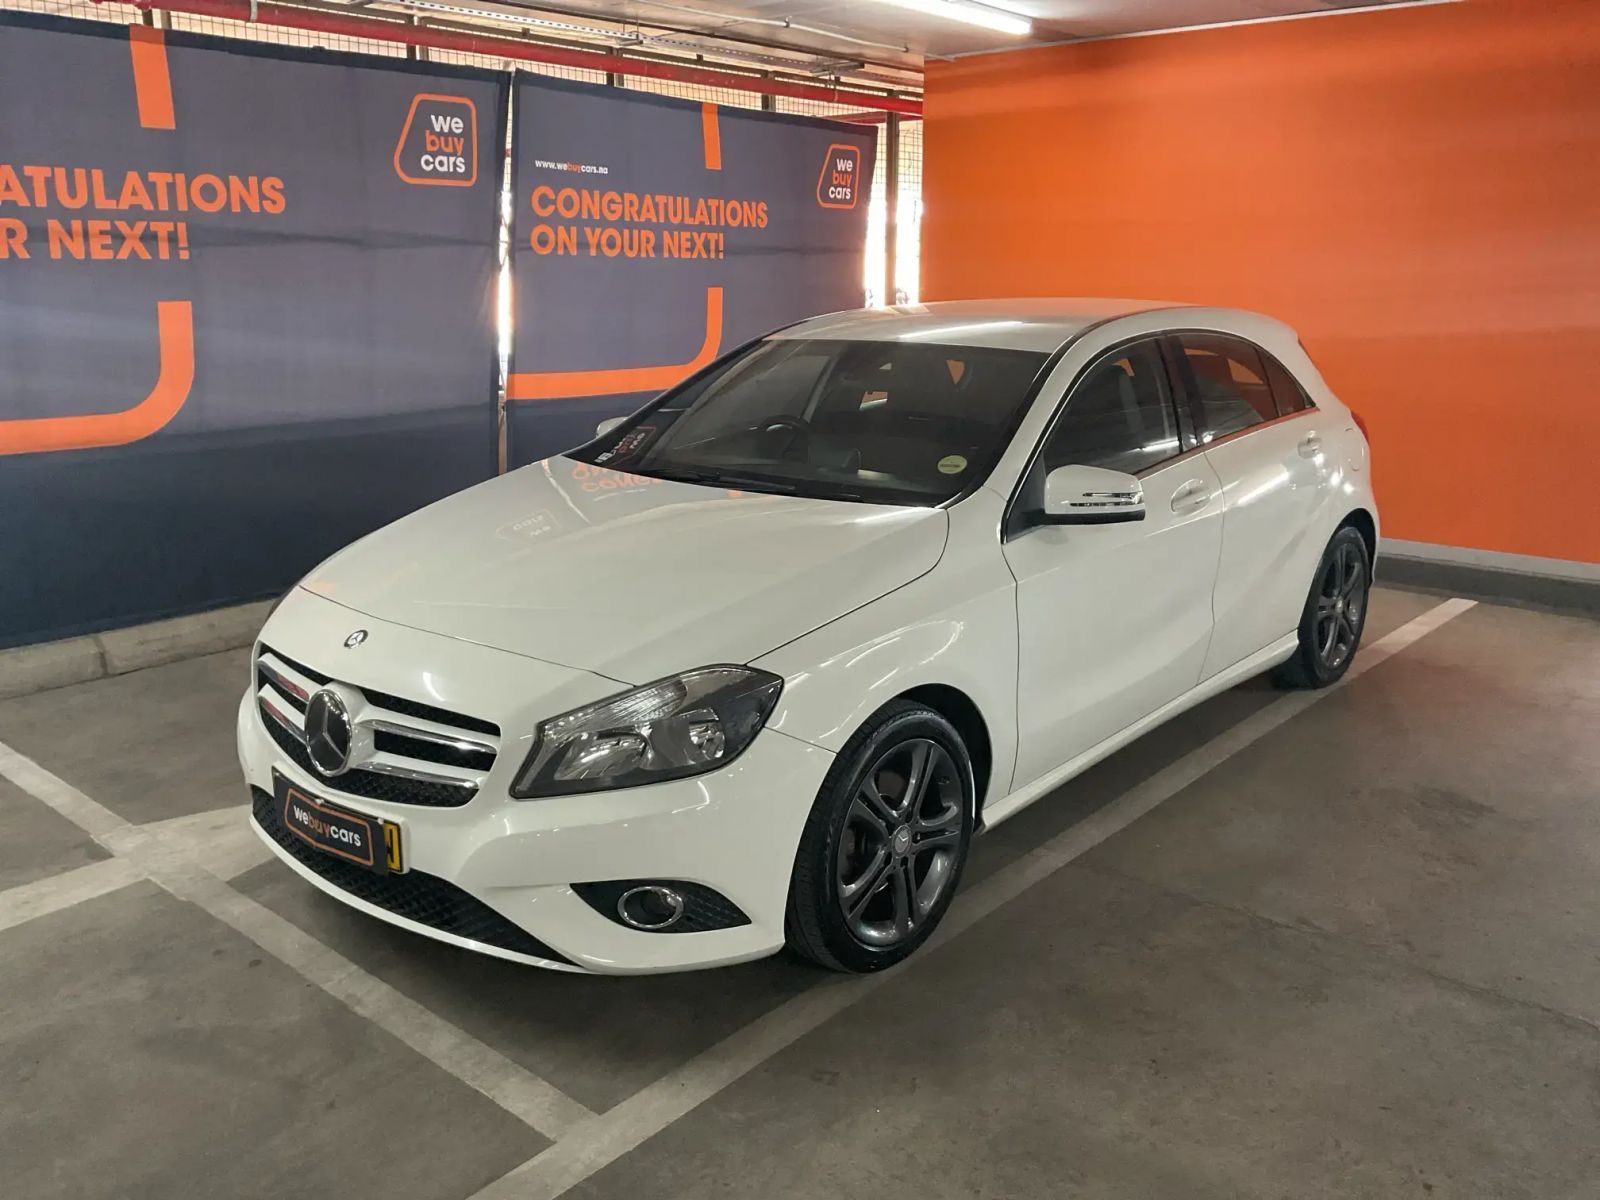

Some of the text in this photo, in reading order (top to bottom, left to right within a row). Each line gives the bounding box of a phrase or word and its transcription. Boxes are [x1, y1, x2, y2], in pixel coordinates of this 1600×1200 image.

[431, 114, 464, 133] we
[425, 130, 464, 156] buy
[420, 154, 466, 173] cars
[535, 160, 608, 175] www.webuycars.na
[837, 158, 853, 171] we
[832, 169, 852, 187] buy
[829, 186, 851, 200] cars
[531, 185, 768, 229] CONGRATULATIONS
[48, 218, 190, 260] NEXT!
[530, 223, 724, 260] ON YOUR NEXT!
[293, 804, 362, 847] webuycars
